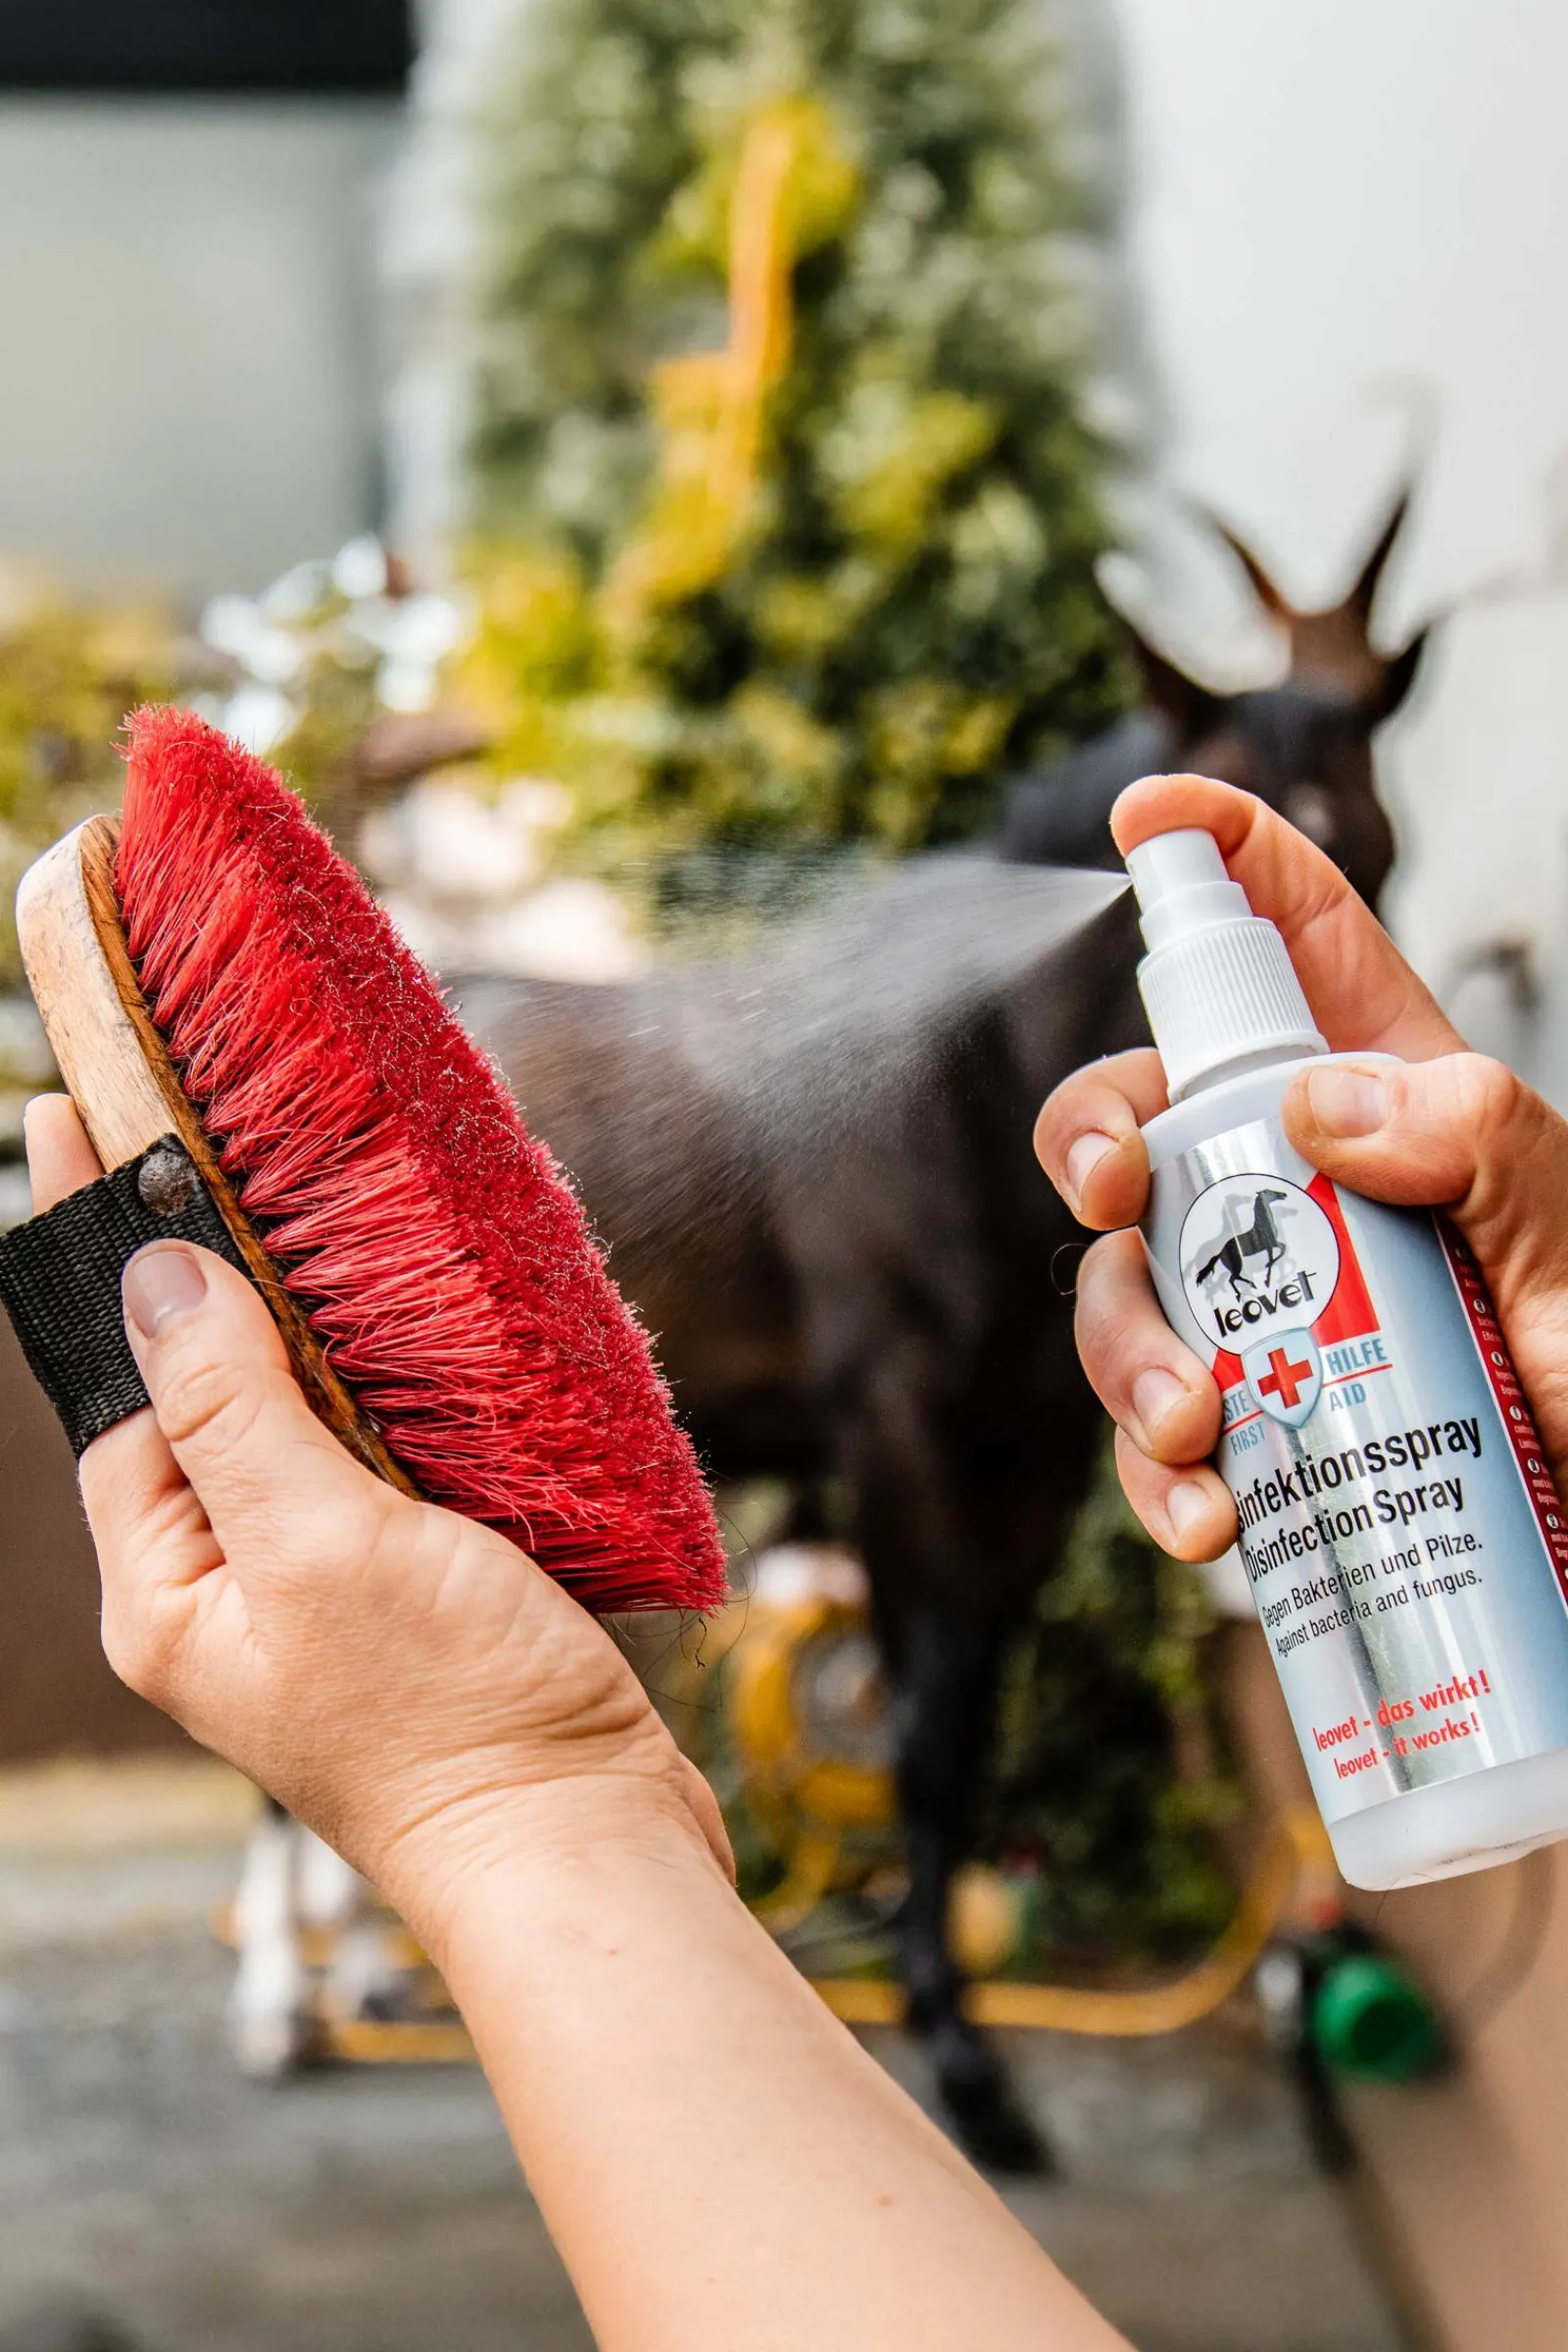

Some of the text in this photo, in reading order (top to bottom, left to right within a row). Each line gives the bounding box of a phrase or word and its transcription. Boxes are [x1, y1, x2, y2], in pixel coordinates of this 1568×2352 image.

[1213, 1270, 1317, 1338] leovet
[1221, 1338, 1388, 1425] STE HILFE
[1230, 1382, 1367, 1456] FIRST AID
[1237, 1417, 1482, 1535] infektionsspray
[1245, 1477, 1464, 1584] Disinfection Spray
[1261, 1533, 1484, 1629] Gegen Bakterien und Pilze.
[1275, 1568, 1483, 1658] Against bacteria and fungus.
[1312, 1716, 1359, 1751] leovet
[1376, 1699, 1415, 1727] das
[1333, 1747, 1379, 1779] leovet
[1392, 1737, 1409, 1758] it
